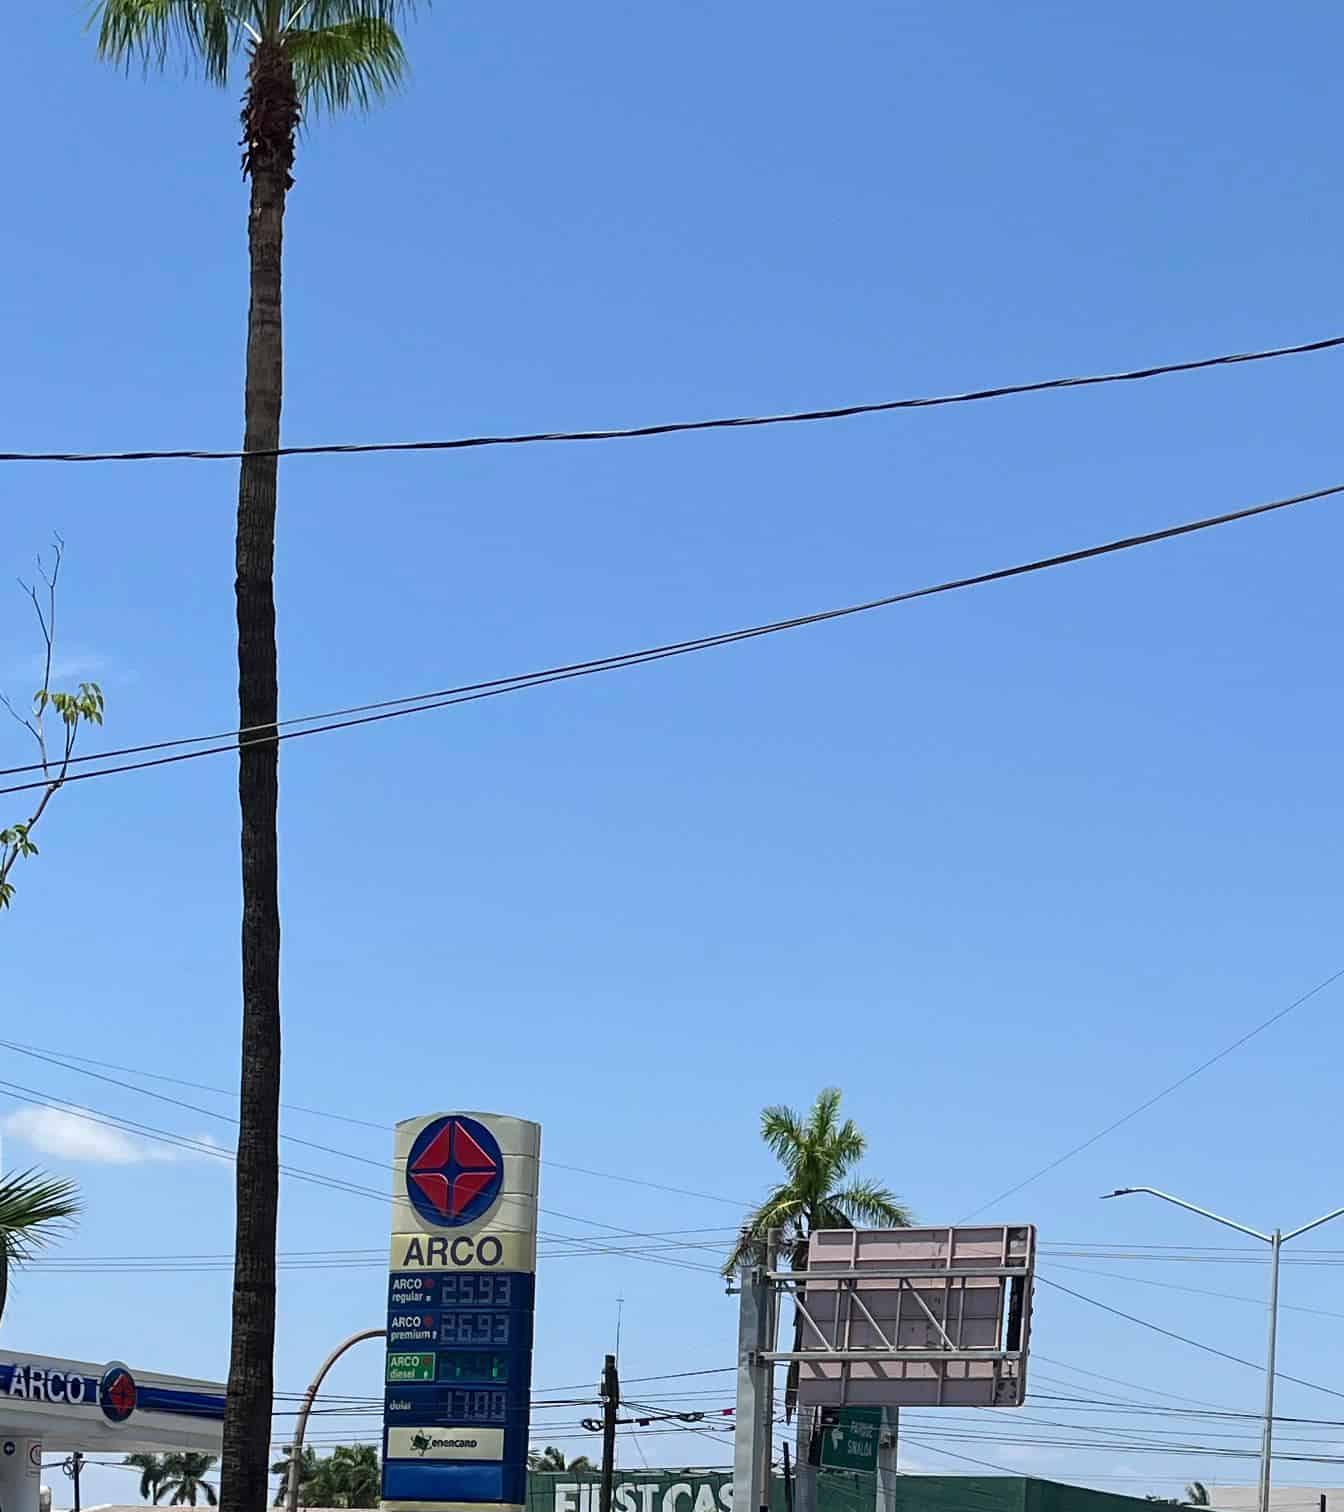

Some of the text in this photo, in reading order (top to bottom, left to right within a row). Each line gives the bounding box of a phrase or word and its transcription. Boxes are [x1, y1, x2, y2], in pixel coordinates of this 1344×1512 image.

[402, 1236, 503, 1266] ARCO
[392, 1279, 422, 1290] ARCO
[391, 1291, 424, 1304] regular
[391, 1317, 421, 1328] ARCO
[390, 1328, 431, 1342] premium
[390, 1355, 420, 1367] ARCO
[9, 1365, 86, 1404] ARCO
